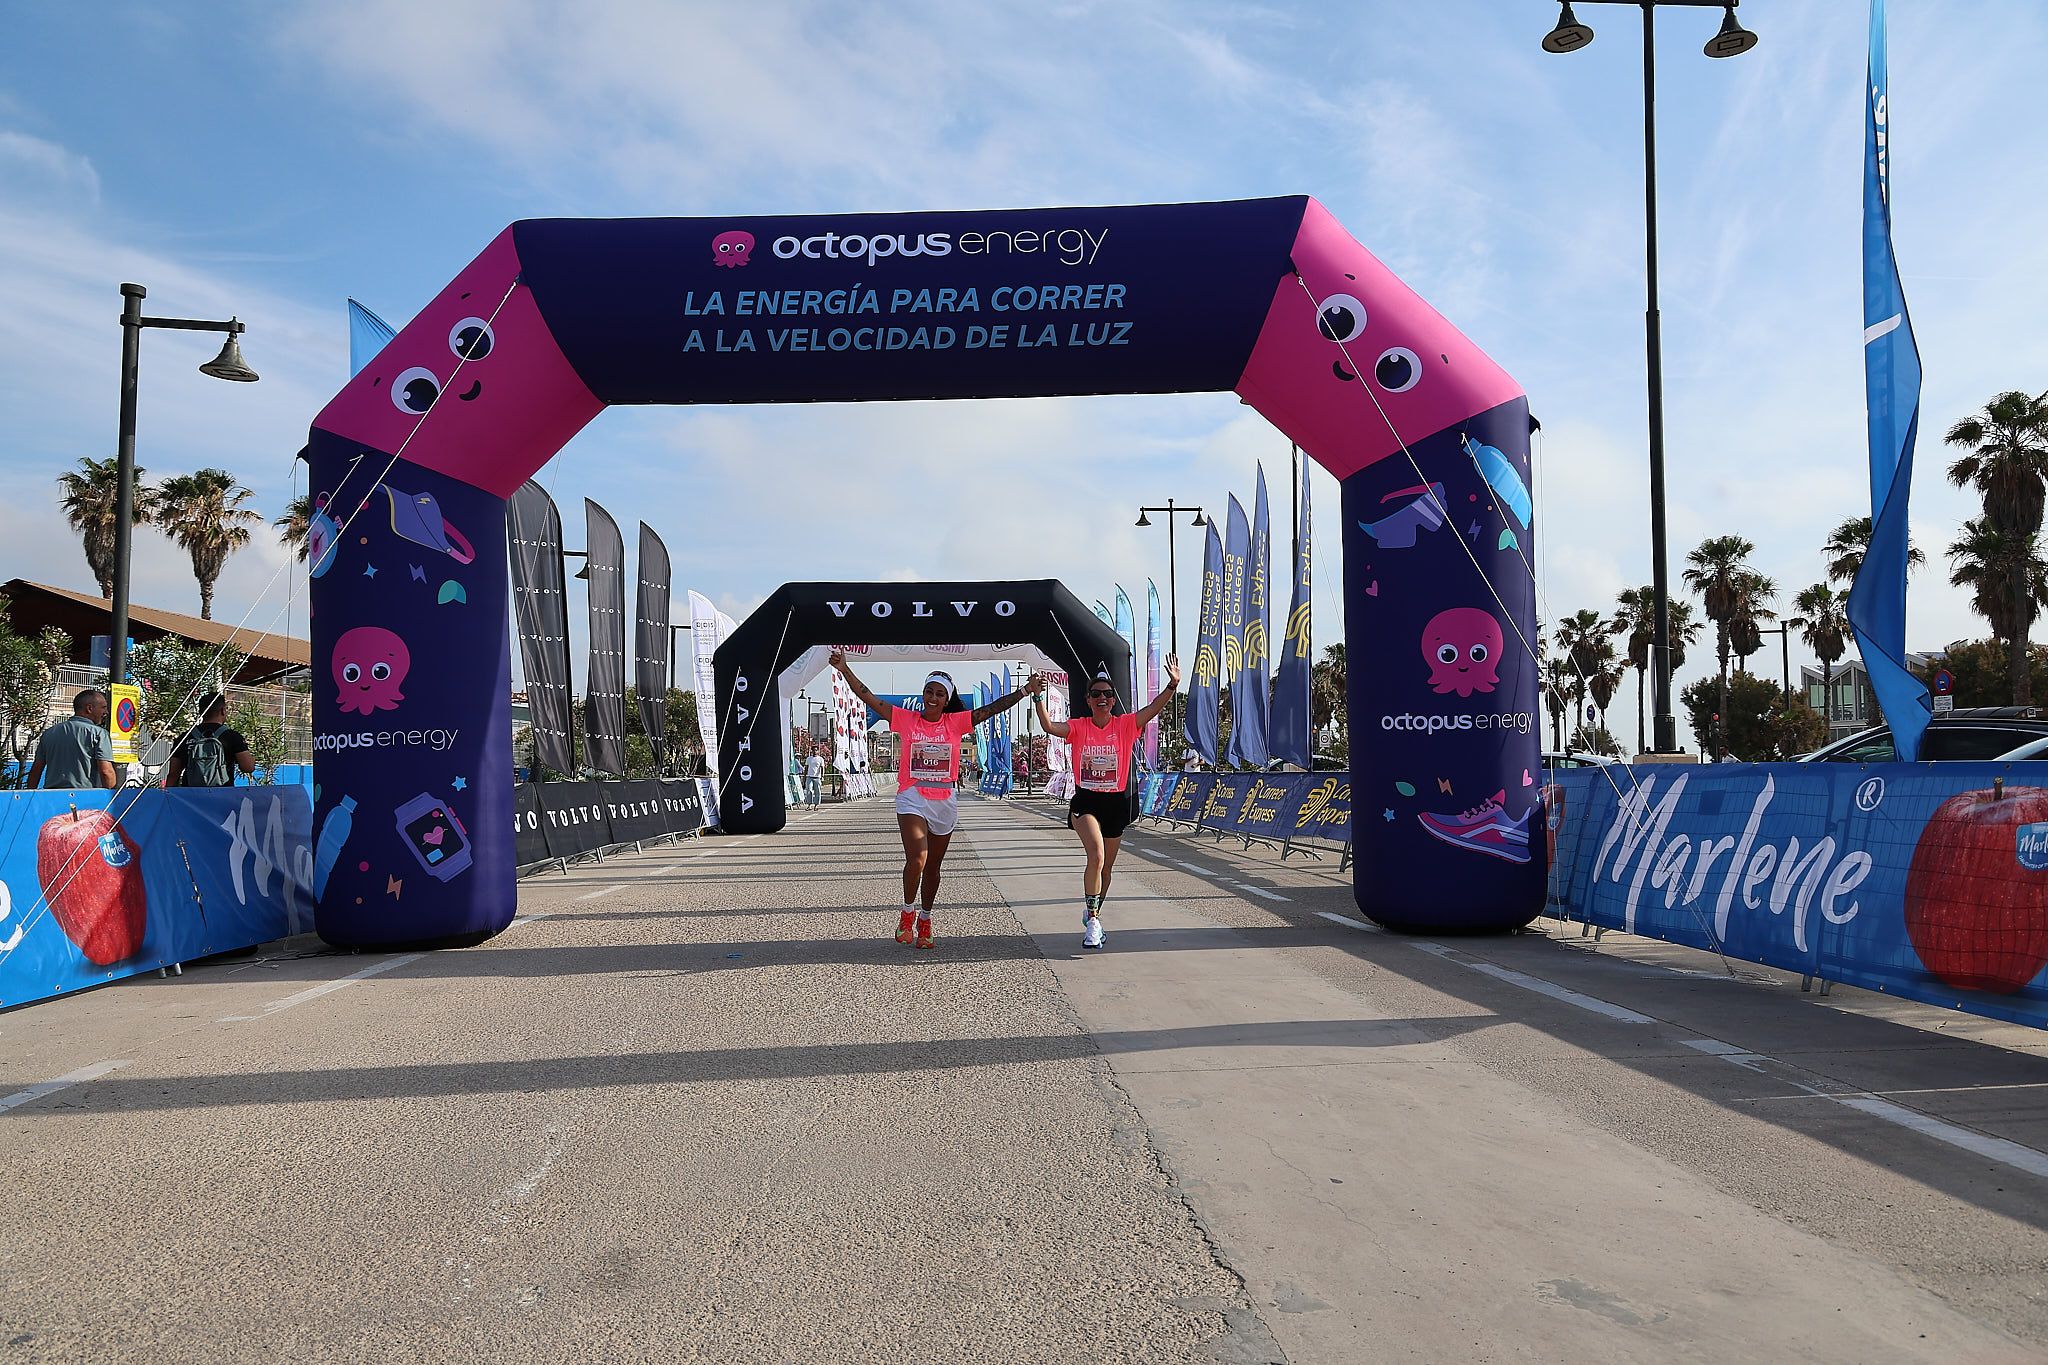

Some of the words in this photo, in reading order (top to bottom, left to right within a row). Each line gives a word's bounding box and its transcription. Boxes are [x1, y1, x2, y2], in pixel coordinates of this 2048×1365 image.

[772, 232, 952, 266] octopus
[958, 228, 1109, 266] energy
[683, 291, 726, 316] LA
[735, 283, 881, 315] ENERGÍA
[890, 287, 981, 313] PARA
[990, 284, 1128, 312] CORRER
[682, 329, 706, 353] A
[714, 328, 758, 353] LA
[766, 326, 957, 352] VELOCIDAD
[965, 324, 1009, 349] DE
[1016, 323, 1059, 348] LA
[1068, 321, 1135, 346] LUZ
[826, 600, 1016, 618] VOLVO
[1381, 713, 1473, 735] octopus
[1475, 712, 1534, 735] energy
[376, 729, 459, 751] energy
[736, 676, 754, 814] VOLVO
[923, 758, 939, 766] 016
[664, 795, 699, 812] VOLVO
[1259, 784, 1287, 801] Correos
[547, 804, 601, 829] VOLVO
[608, 799, 659, 820] VOLVO
[1249, 803, 1276, 824] Express
[1593, 772, 1873, 953] Marlene
